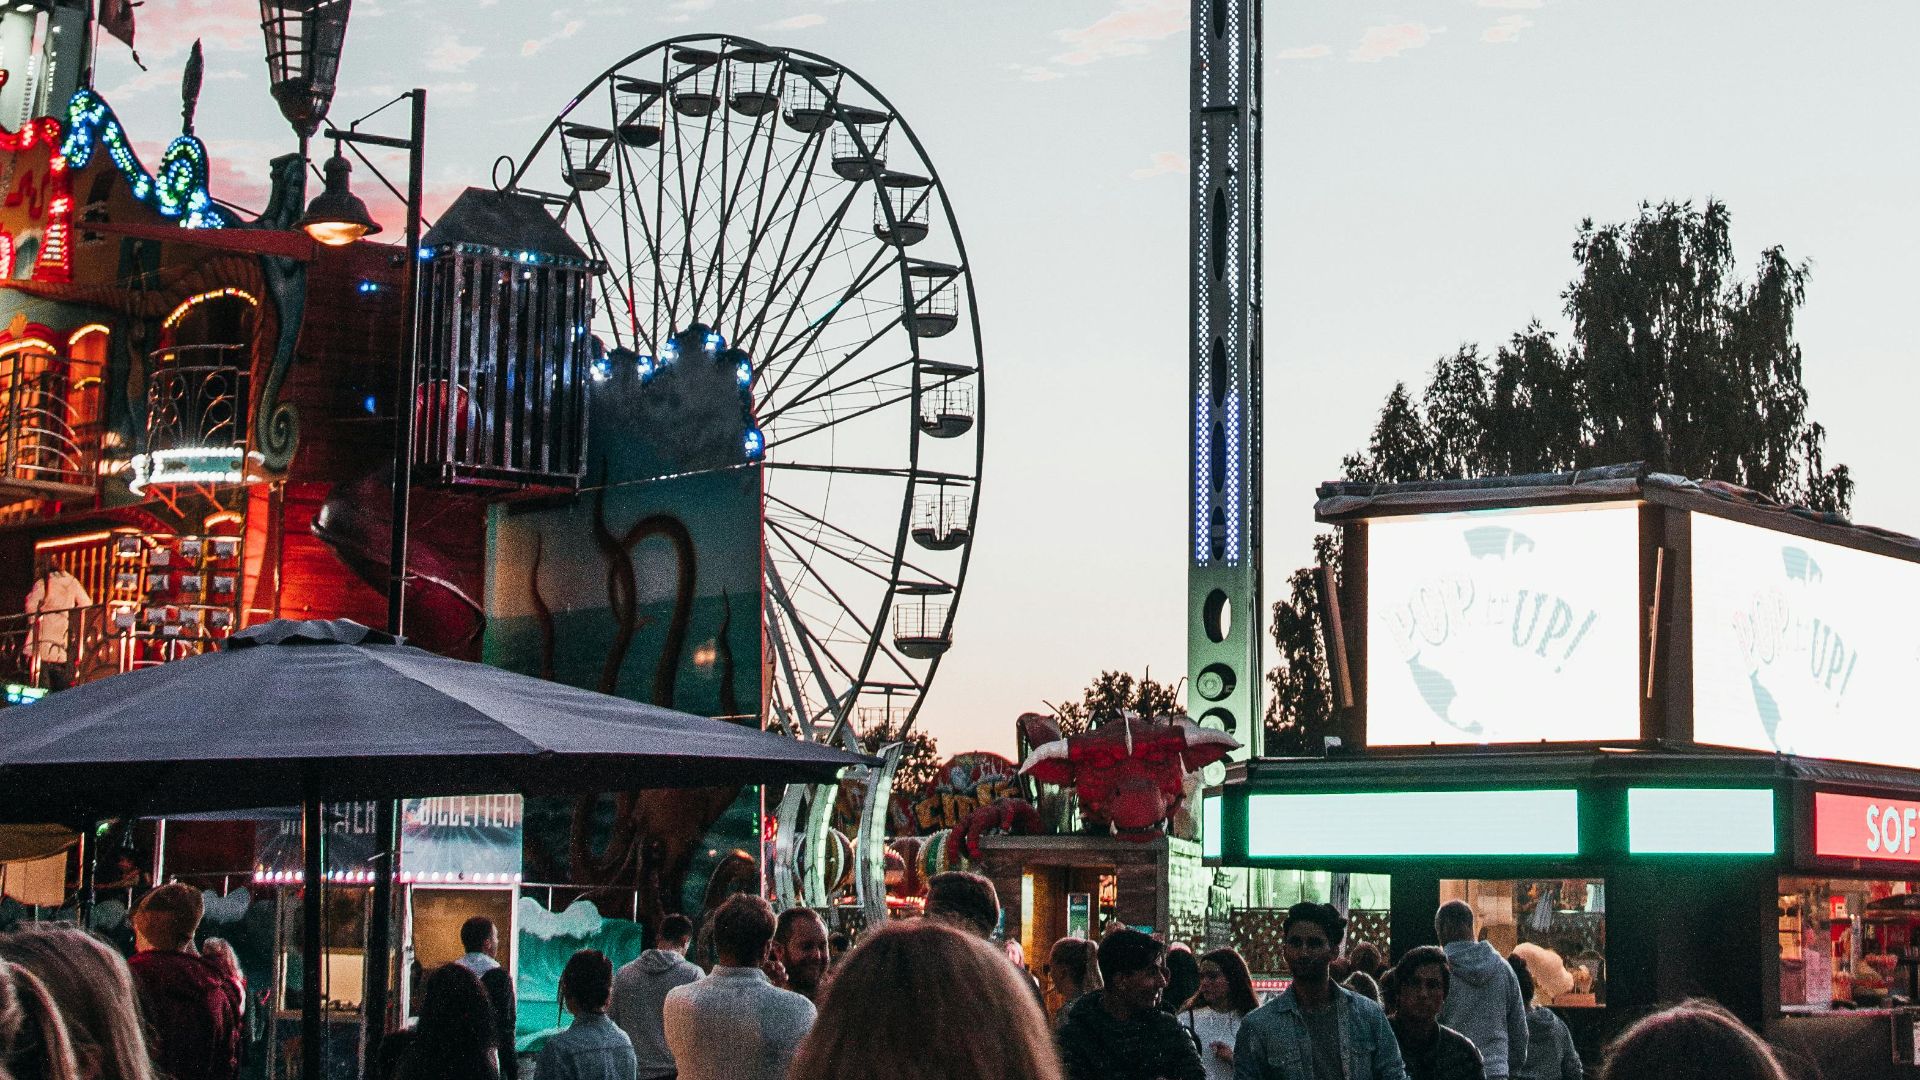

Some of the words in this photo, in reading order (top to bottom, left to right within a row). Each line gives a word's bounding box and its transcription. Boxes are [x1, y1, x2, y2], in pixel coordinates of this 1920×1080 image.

[1512, 589, 1596, 673] UP!
[1811, 617, 1857, 708] UP!
[420, 796, 514, 828] BILLETTER
[1866, 804, 1920, 855] SOF
